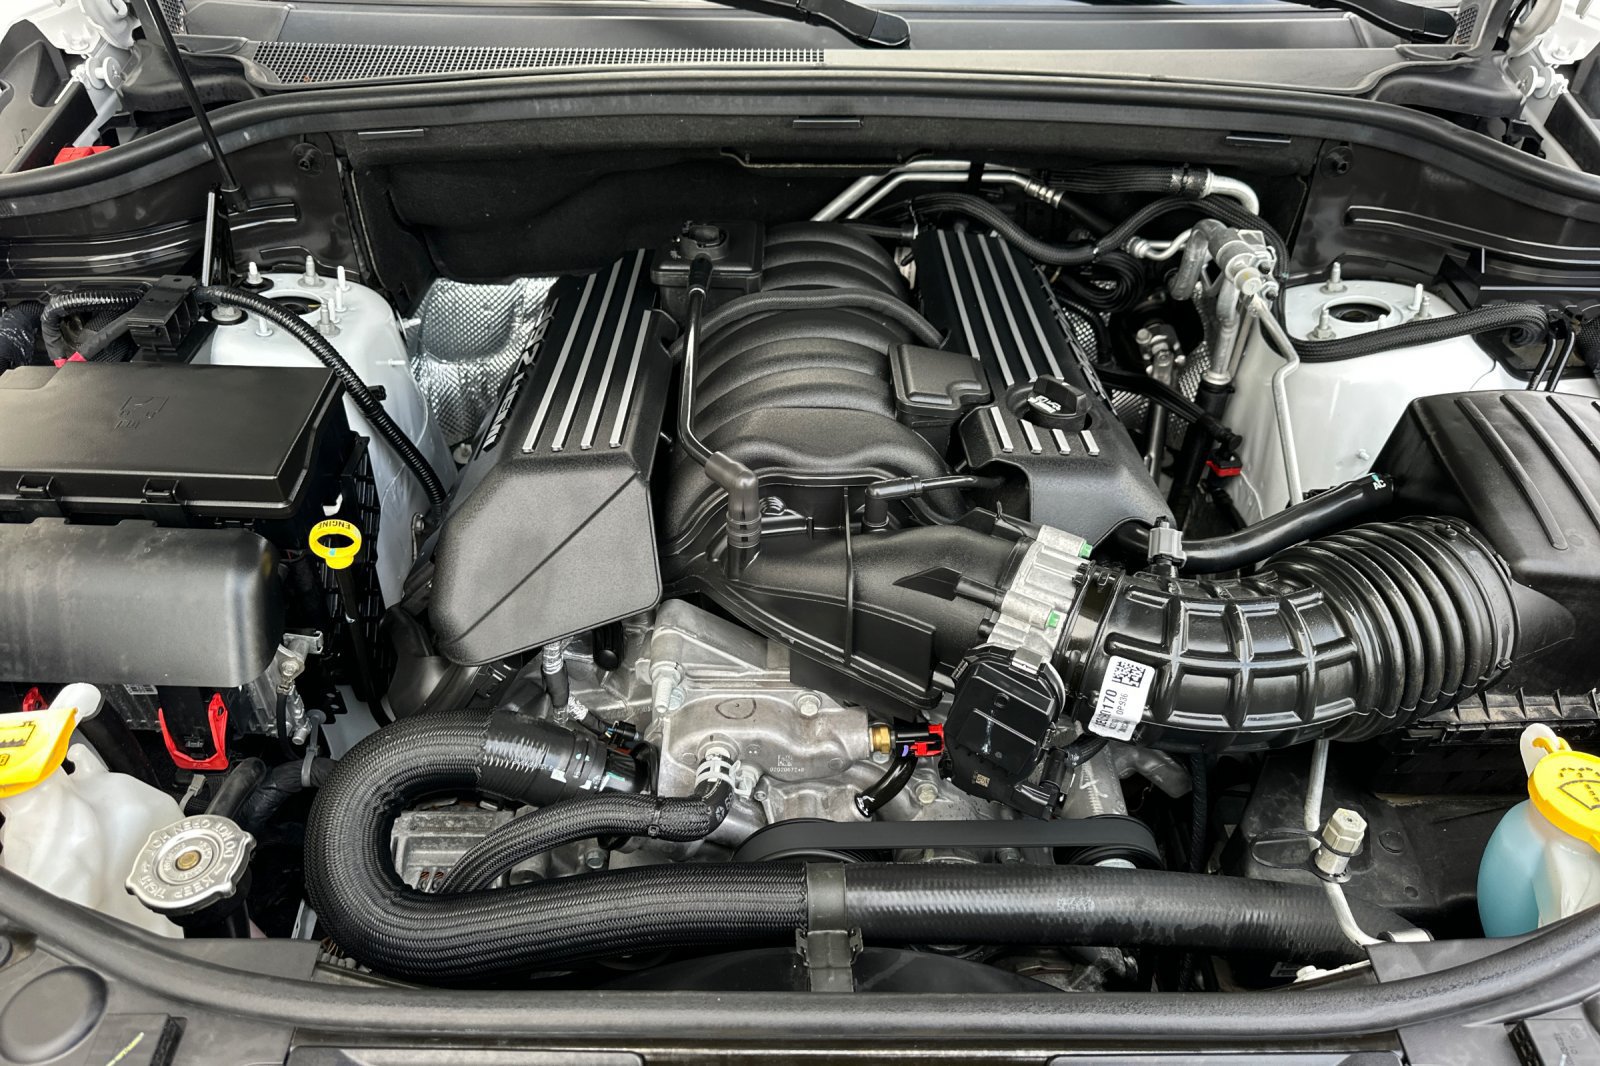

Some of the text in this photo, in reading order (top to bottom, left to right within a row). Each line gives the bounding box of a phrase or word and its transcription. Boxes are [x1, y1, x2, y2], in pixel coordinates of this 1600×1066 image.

[482, 372, 526, 450] HEMI
[1372, 479, 1387, 490] AC
[317, 520, 351, 530] ENGINE
[174, 819, 211, 836] OPEN
[147, 831, 171, 857] HOT
[138, 874, 215, 900] KEEP TIGHT
